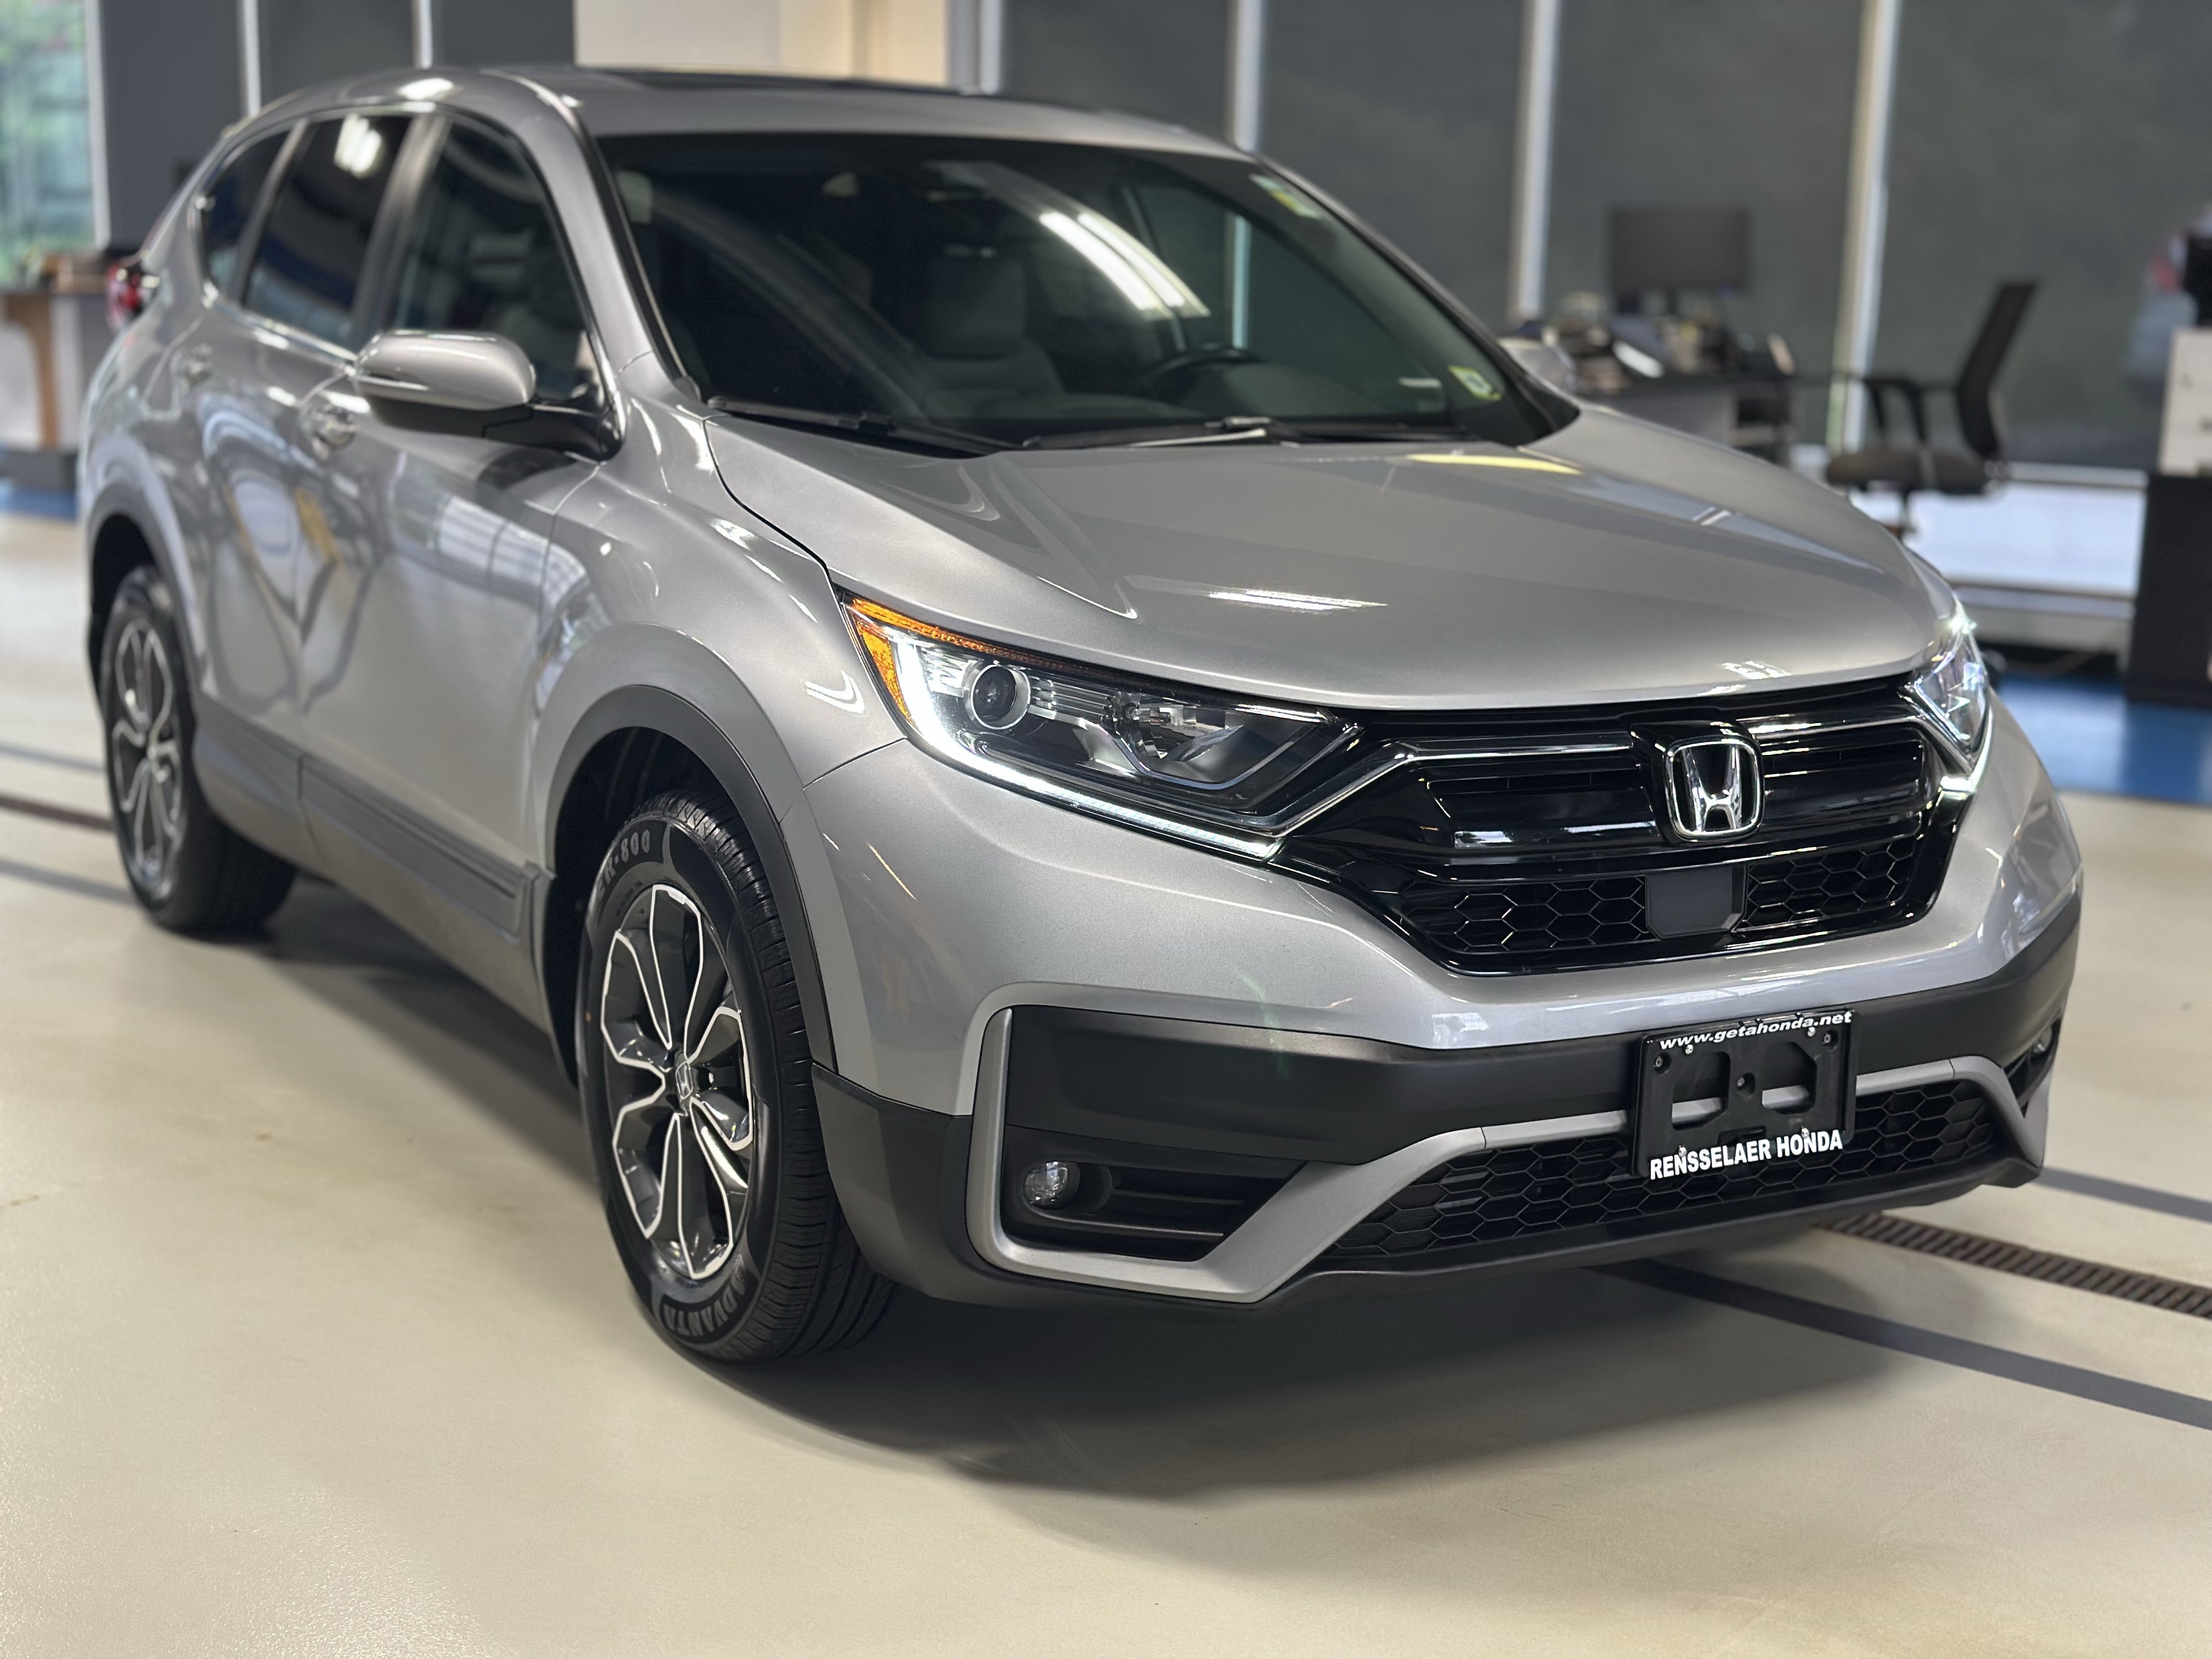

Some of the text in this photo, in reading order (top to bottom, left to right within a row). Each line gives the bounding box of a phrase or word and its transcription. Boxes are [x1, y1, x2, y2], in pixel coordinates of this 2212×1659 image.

[1660, 1011, 1852, 1050] www.getahonda.net
[1650, 1130, 1843, 1180] RENSSELAER HONDA
[663, 1266, 746, 1336] ADVANTA
